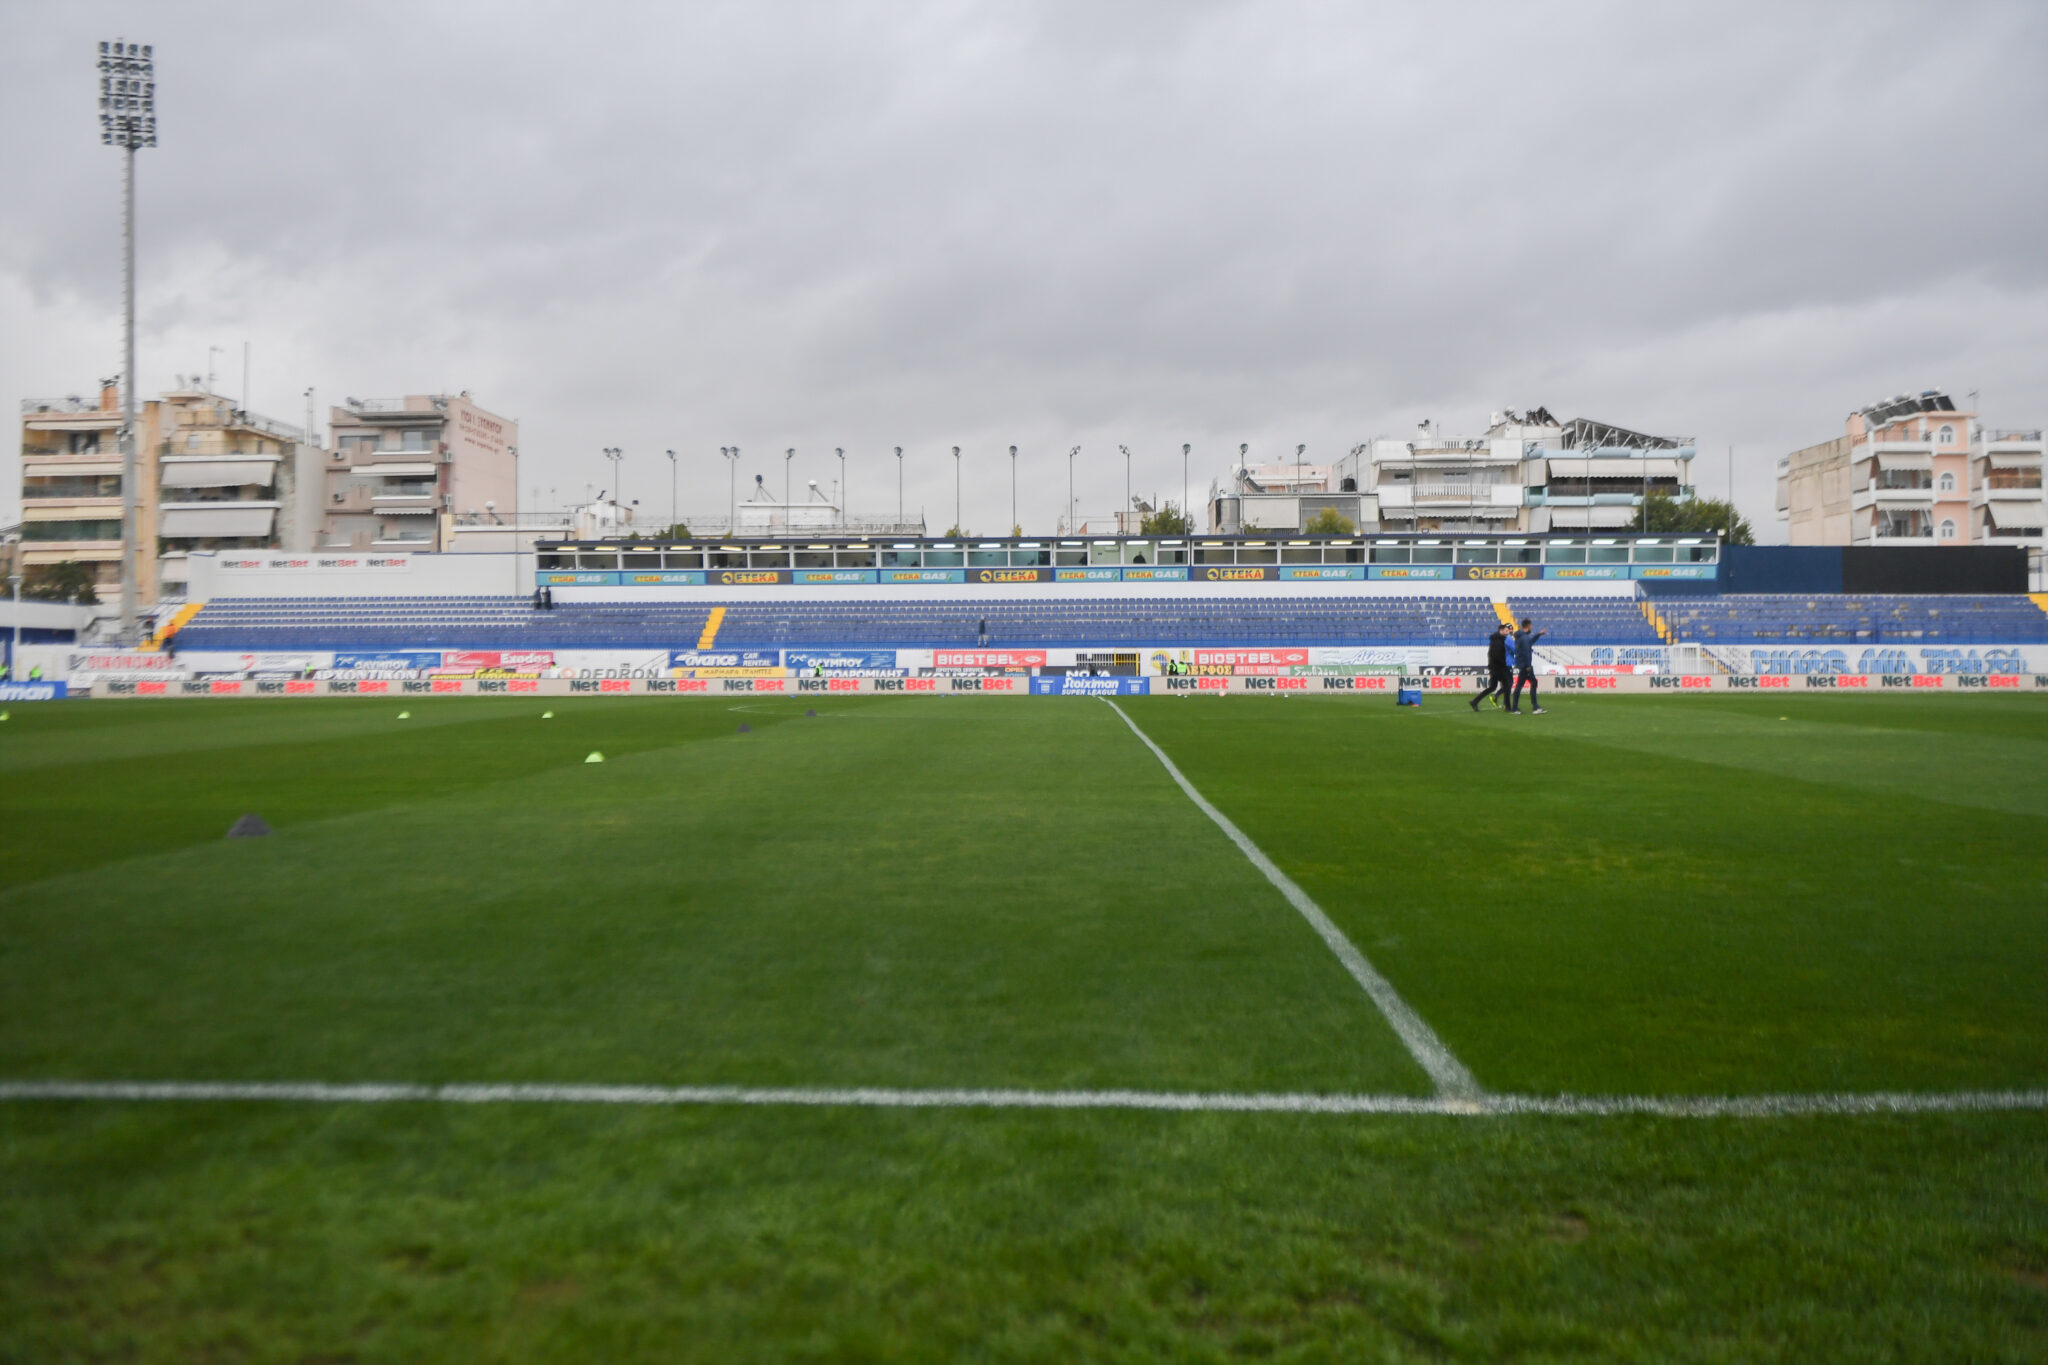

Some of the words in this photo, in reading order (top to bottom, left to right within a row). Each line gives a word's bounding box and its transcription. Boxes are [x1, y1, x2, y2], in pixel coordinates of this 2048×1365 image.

[735, 572, 777, 583] ETEKA
[835, 573, 859, 581] GAS
[994, 571, 1036, 581] ETEKA
[1221, 569, 1263, 579] ETEKA
[1483, 568, 1525, 578] ETEKA
[685, 654, 738, 666] avance
[938, 654, 1018, 665] BIOSTEEL
[1199, 653, 1280, 664] BIOSTEEL
[328, 681, 388, 693] NetBet
[402, 681, 463, 693] NetBet
[478, 680, 538, 692] NetBet
[570, 680, 631, 692] NetBet
[647, 680, 707, 692] NetBet
[724, 680, 784, 691] NetBet
[798, 679, 860, 691] NetBet
[874, 679, 936, 691] NetBet
[952, 678, 1014, 690] NetBet
[1062, 676, 1119, 688] Stoiximan
[1167, 678, 1229, 690] NetBet
[1245, 678, 1307, 689] NetBet
[1324, 677, 1386, 689] NetBet
[1555, 676, 1617, 688] NetBet
[1650, 676, 1712, 688] NetBet
[1728, 676, 1790, 688] NetBet
[1807, 676, 1868, 688] NetBet
[1882, 676, 1943, 688] NetBet
[1958, 675, 2020, 687] NetBet
[108, 682, 167, 695] NetBet
[183, 681, 241, 694] NetBet
[257, 681, 315, 694] NetBet
